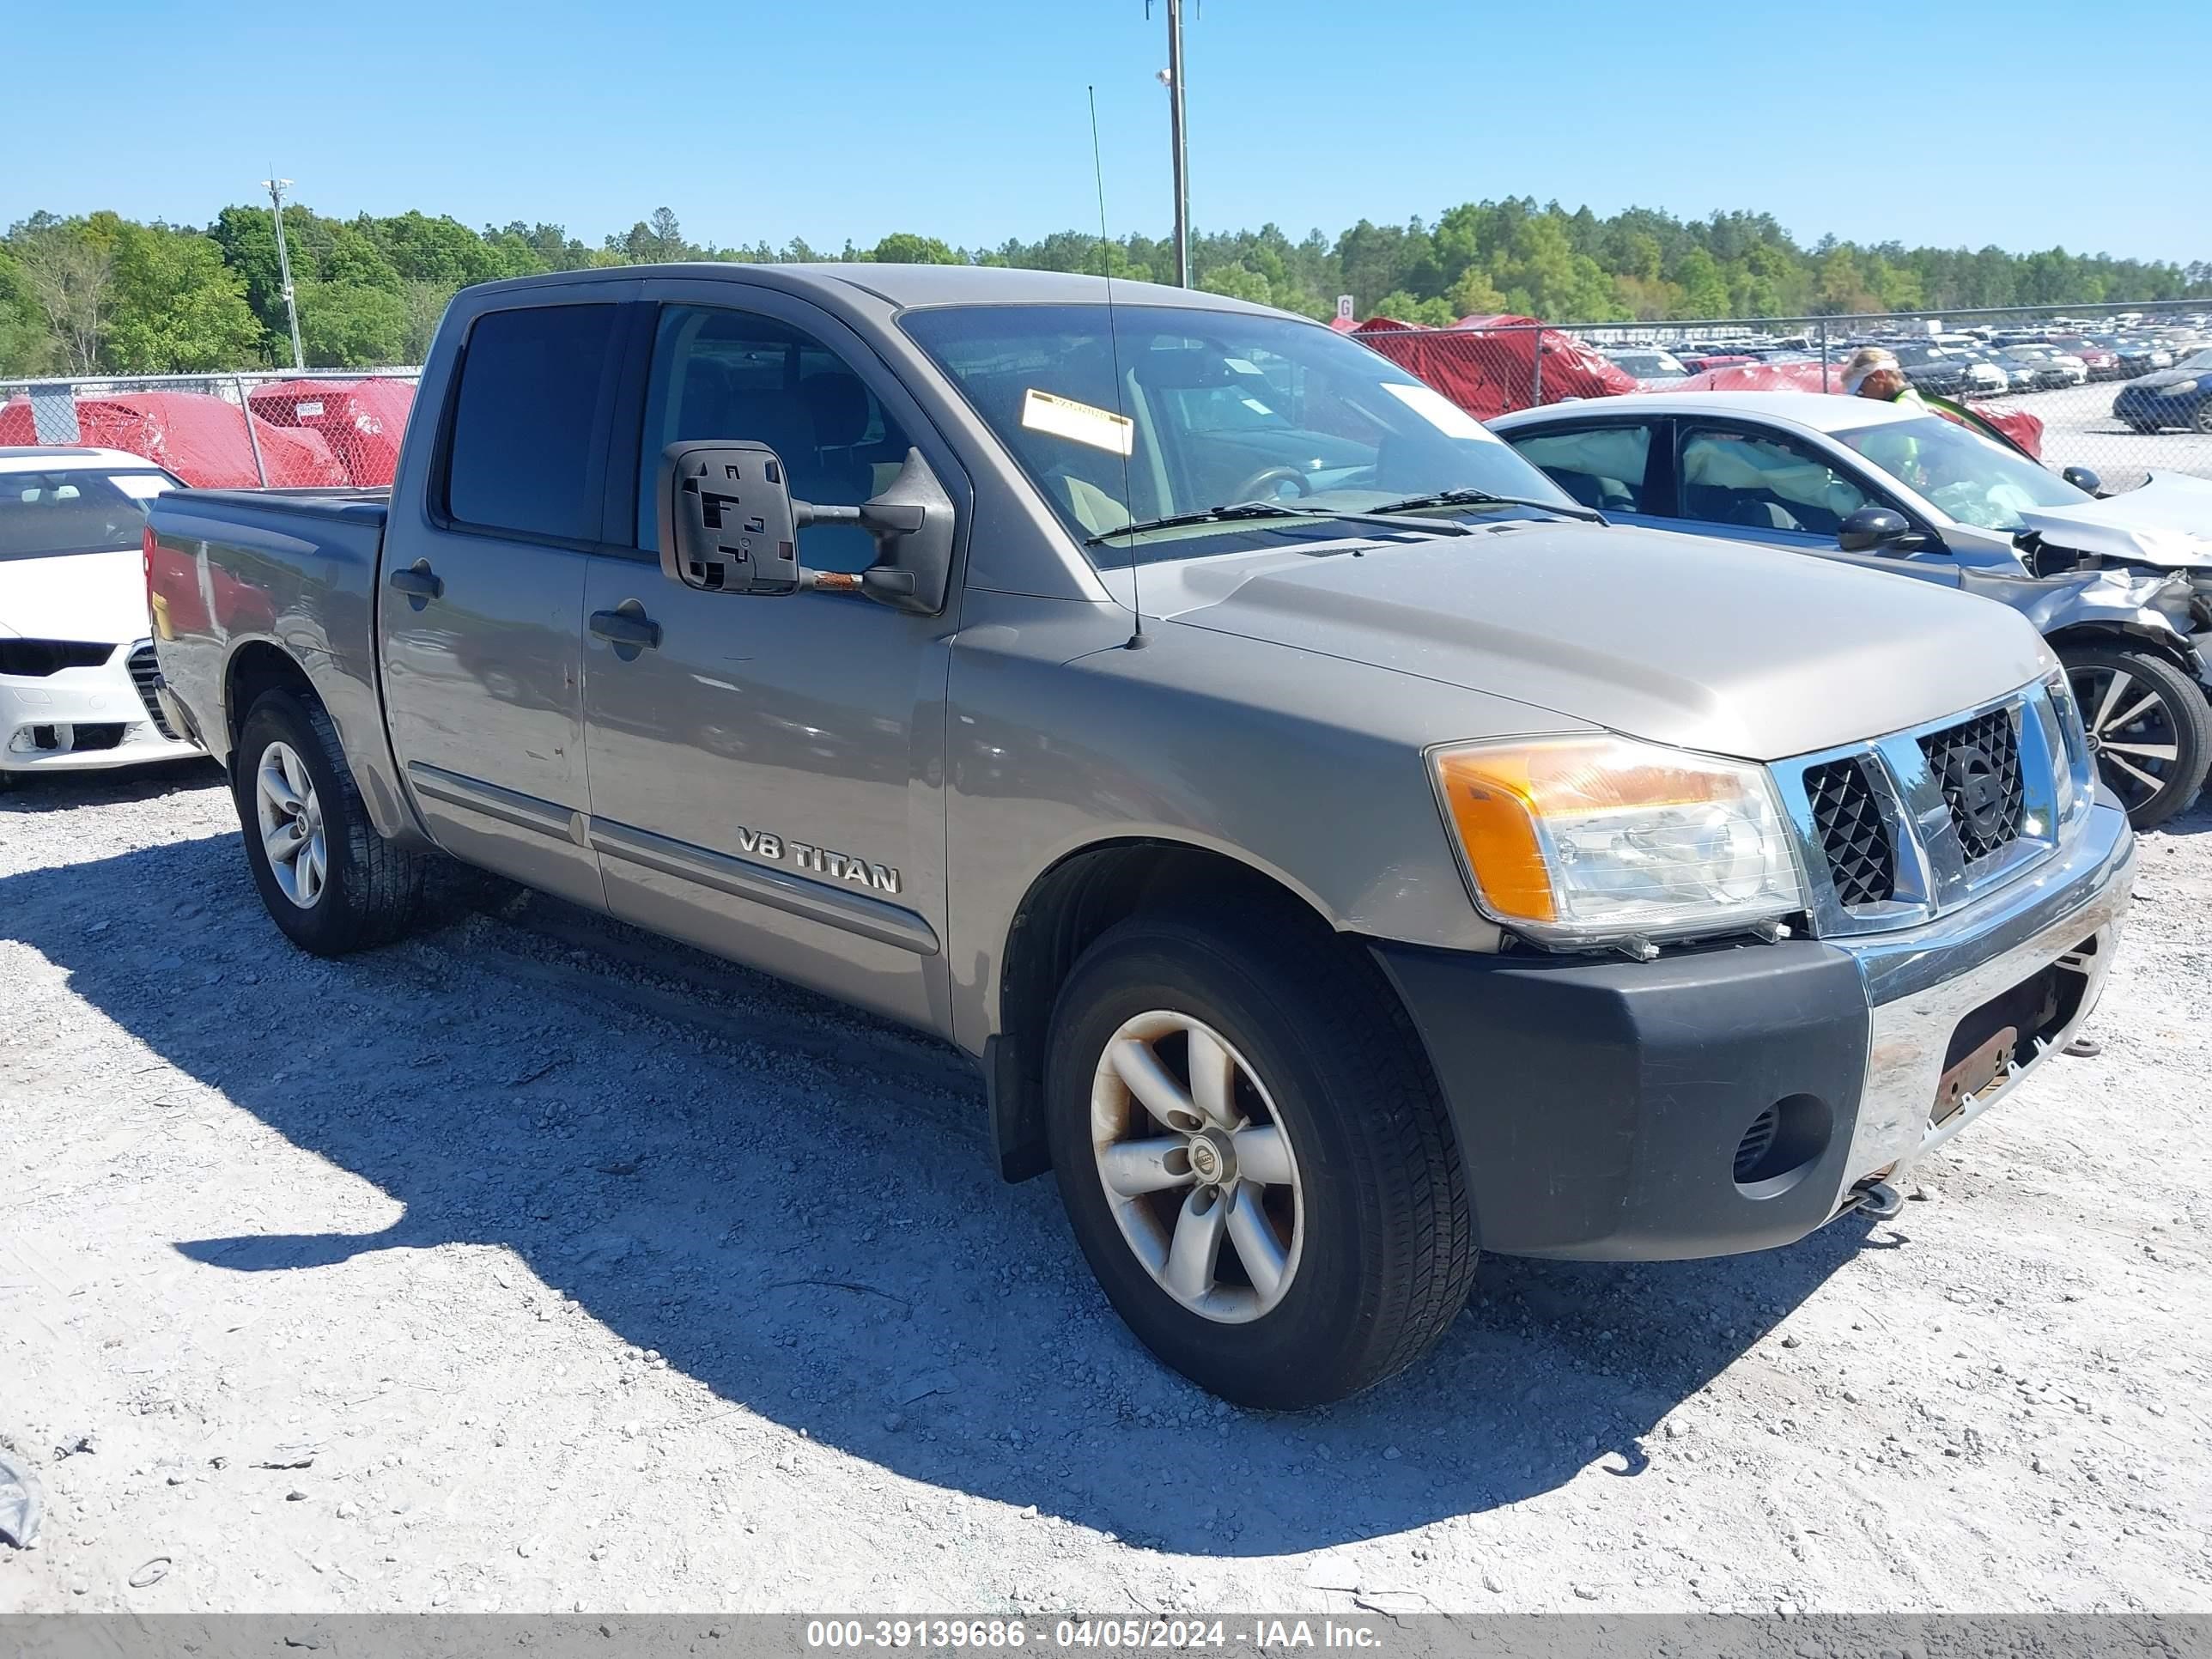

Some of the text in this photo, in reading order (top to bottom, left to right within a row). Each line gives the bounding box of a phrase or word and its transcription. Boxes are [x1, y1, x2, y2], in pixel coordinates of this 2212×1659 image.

[1341, 299, 1351, 317] G
[737, 825, 902, 895] V8 TITAN
